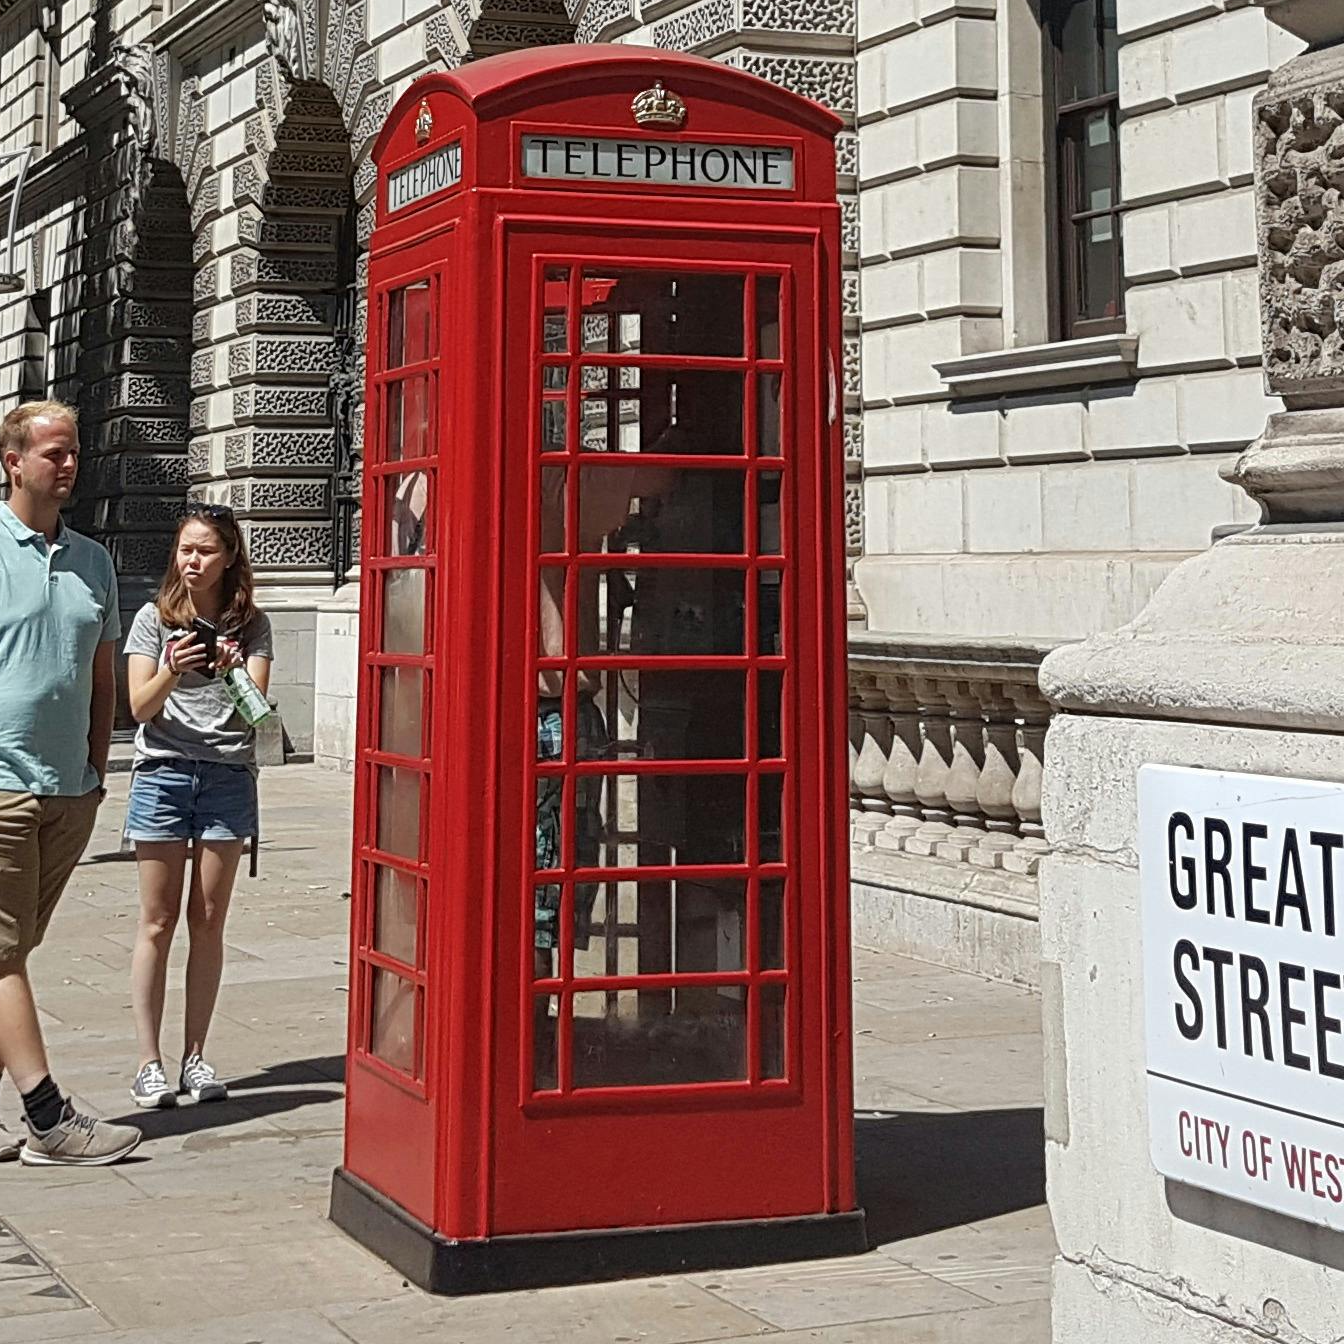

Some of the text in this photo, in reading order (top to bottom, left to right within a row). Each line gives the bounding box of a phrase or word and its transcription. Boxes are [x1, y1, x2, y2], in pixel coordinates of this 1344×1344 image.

[391, 145, 461, 208] TELEPHONE
[530, 138, 782, 186] TELEPHONE
[1167, 811, 1344, 937] GREAT
[1178, 1110, 1231, 1169] CITY
[1242, 1129, 1273, 1181] OF
